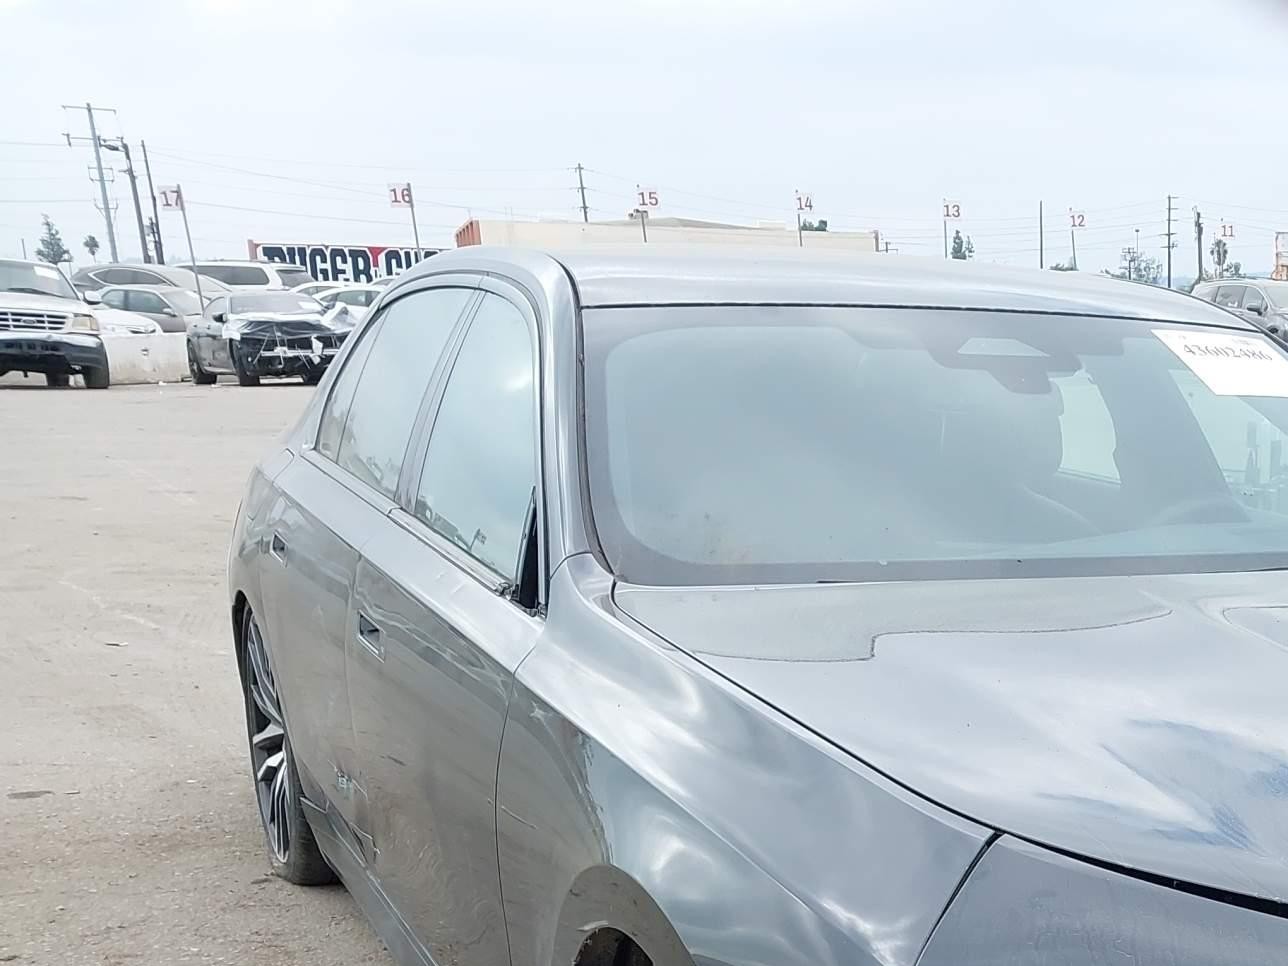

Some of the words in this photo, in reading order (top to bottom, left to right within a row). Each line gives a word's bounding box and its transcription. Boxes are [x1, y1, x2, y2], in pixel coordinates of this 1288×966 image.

[160, 190, 181, 207] 17
[390, 188, 412, 204] 16
[638, 191, 659, 206] 15
[796, 196, 813, 211] 14
[943, 204, 961, 218] 13
[1070, 214, 1086, 227] 12
[1221, 225, 1235, 237] 11
[1183, 344, 1273, 361] 43602486
